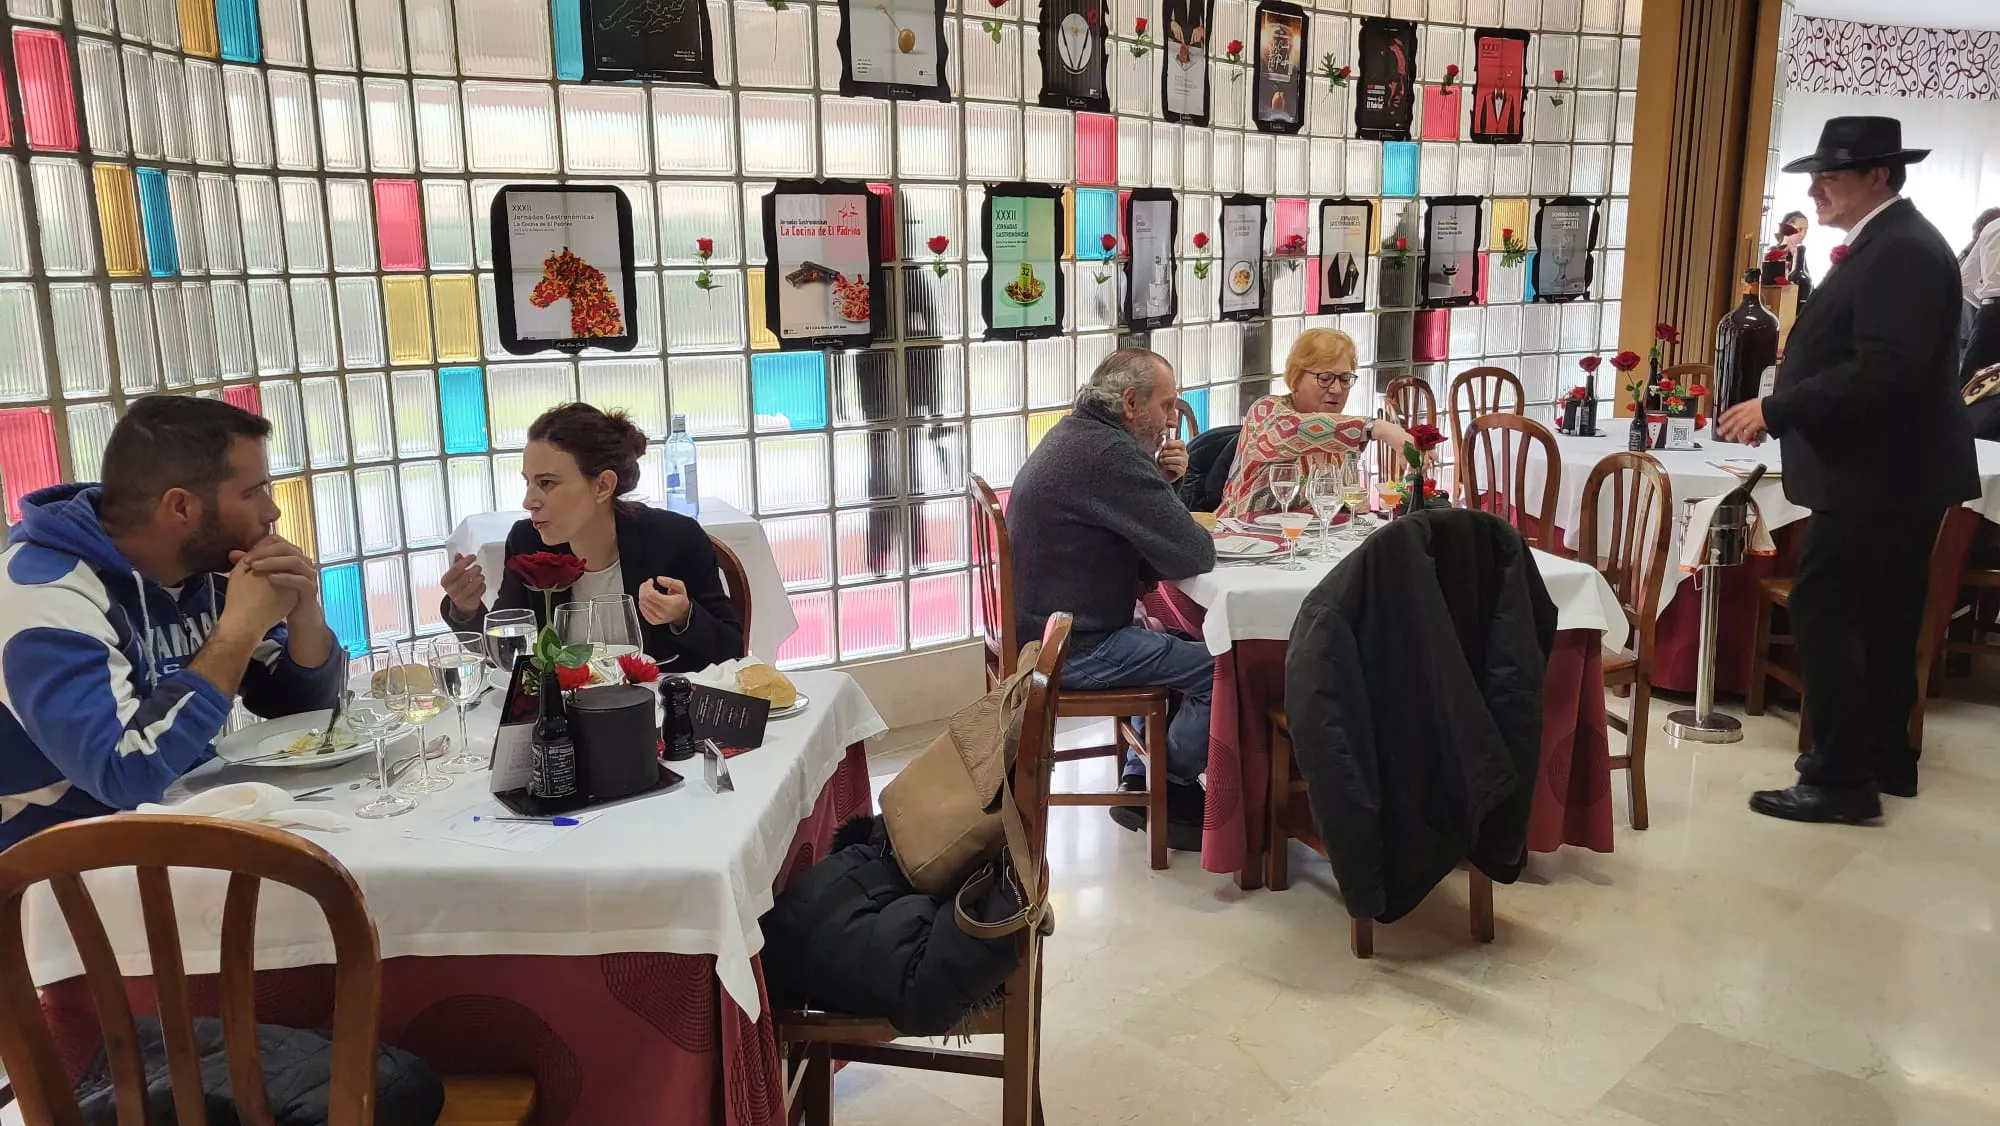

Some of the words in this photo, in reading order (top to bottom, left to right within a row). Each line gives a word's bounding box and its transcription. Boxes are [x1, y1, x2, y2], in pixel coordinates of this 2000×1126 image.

[996, 209, 1016, 220] XXXII
[780, 226, 790, 236] La
[792, 226, 816, 236] Cocina
[818, 226, 827, 236] de
[828, 225, 835, 236] El
[837, 225, 861, 236] Padrino
[1021, 267, 1030, 277] 32
[136, 611, 215, 663] YAMA
